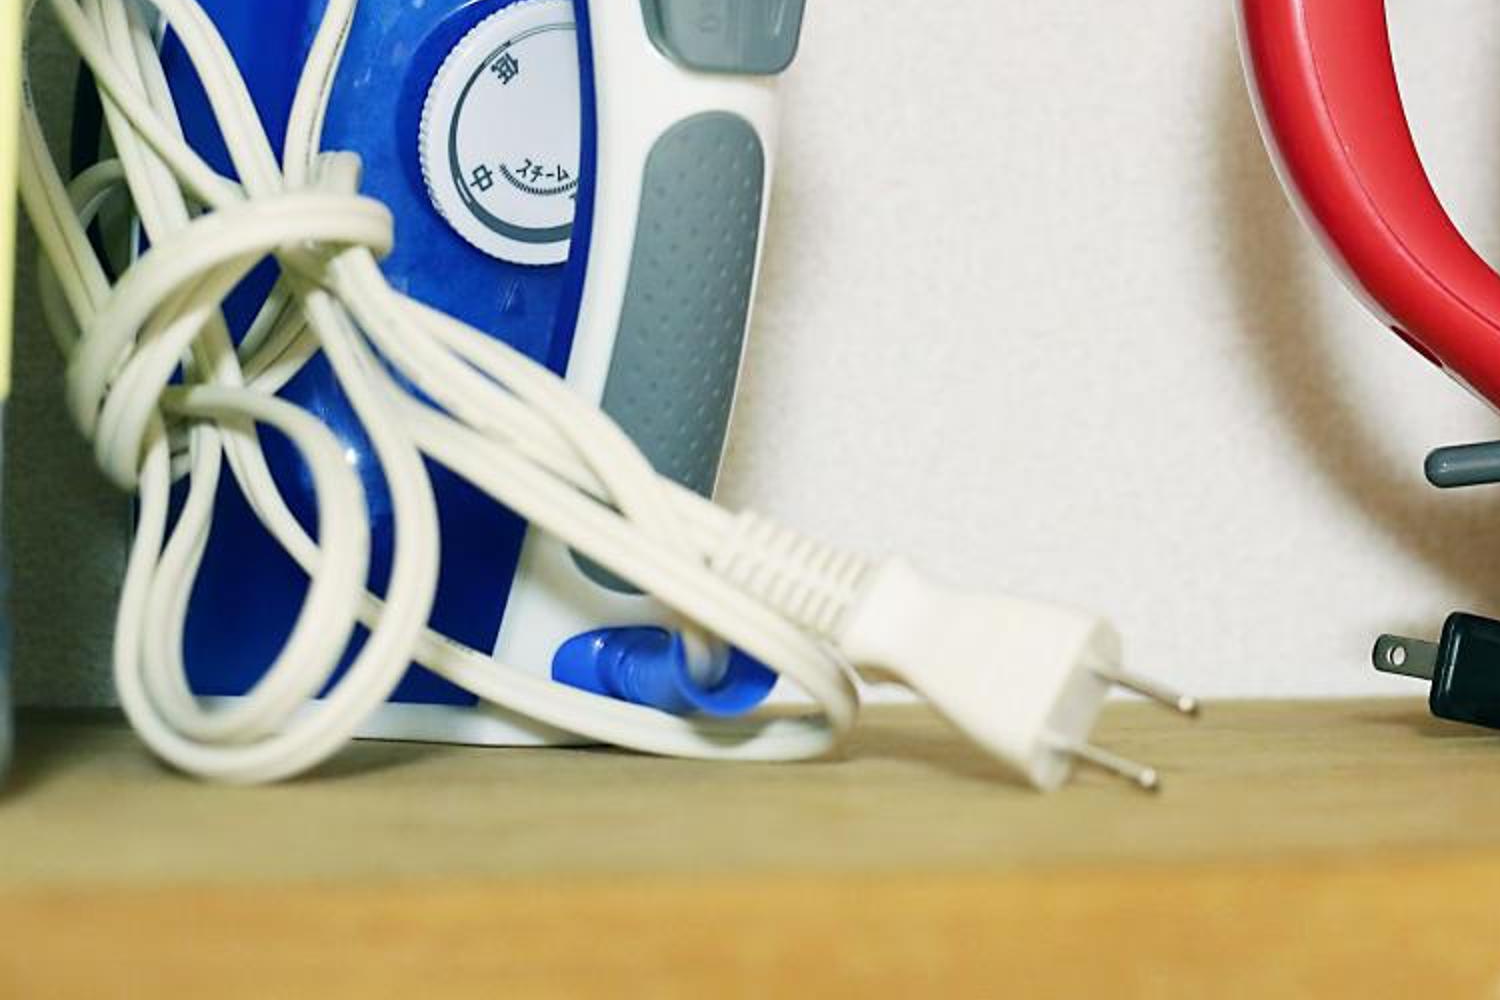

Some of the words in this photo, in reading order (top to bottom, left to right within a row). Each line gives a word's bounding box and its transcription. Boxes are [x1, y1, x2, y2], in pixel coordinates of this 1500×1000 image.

[490, 52, 520, 85] 低
[469, 164, 494, 192] 中
[516, 158, 570, 183] スチーム
